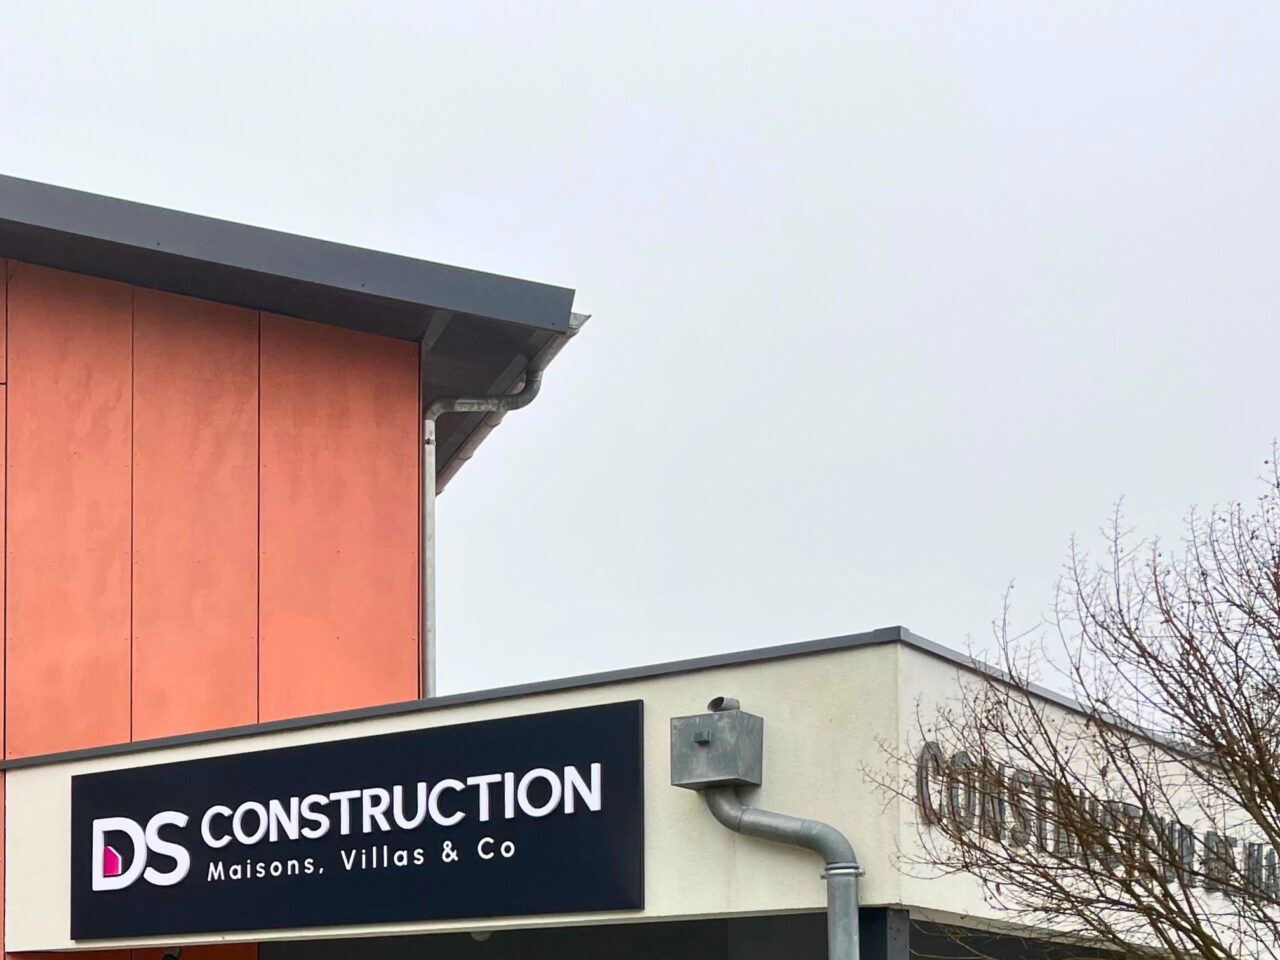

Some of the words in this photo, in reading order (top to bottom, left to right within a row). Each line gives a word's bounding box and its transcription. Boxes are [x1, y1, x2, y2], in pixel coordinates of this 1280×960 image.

[92, 811, 192, 891] DS
[201, 763, 602, 849] CONSTRUCTION
[207, 857, 324, 881] Maisons,
[341, 845, 424, 871] Villas
[441, 840, 459, 863] &
[477, 837, 515, 859] Co
